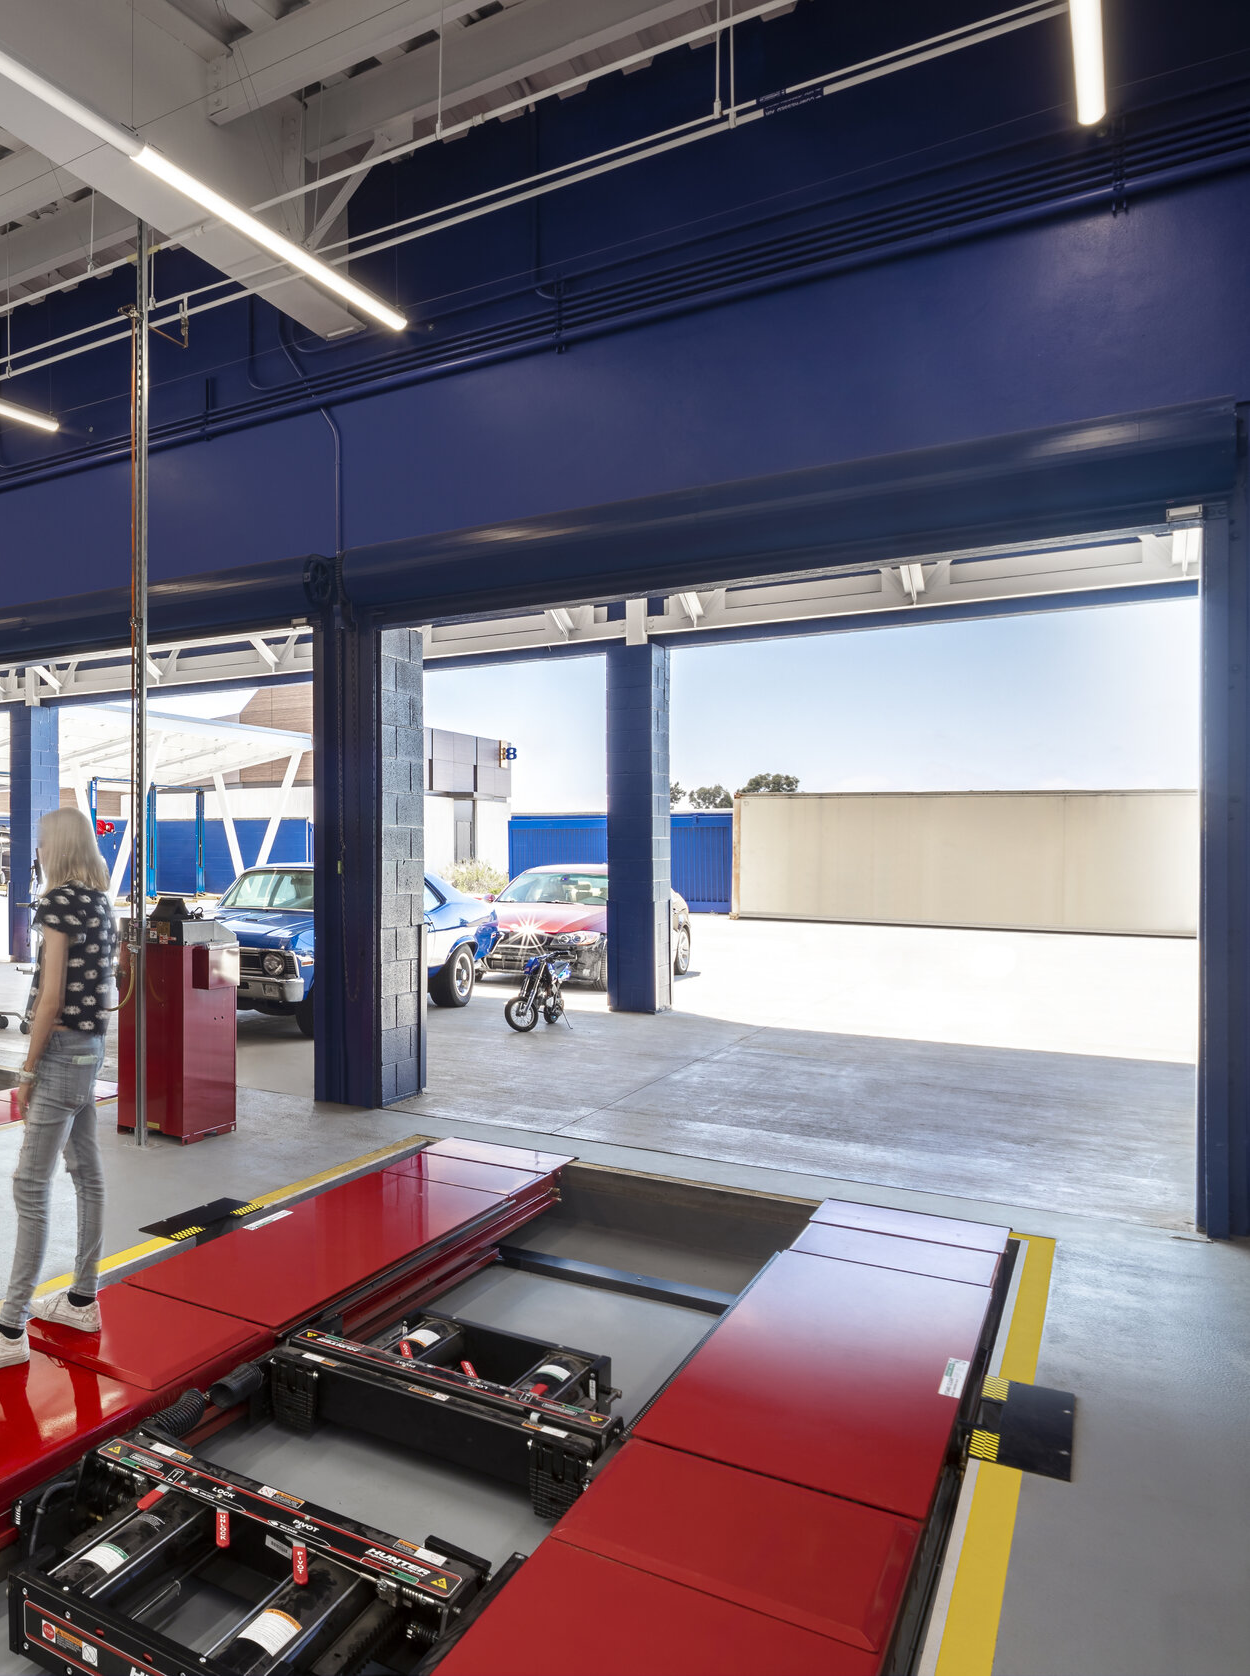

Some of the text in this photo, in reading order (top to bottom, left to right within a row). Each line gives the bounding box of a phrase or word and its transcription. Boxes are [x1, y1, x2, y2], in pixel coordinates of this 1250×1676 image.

[212, 1486, 235, 1499] LOCK
[219, 1514, 227, 1541] UNLOCK
[292, 1518, 320, 1533] PIVOT
[366, 1548, 431, 1576] HUNTER
